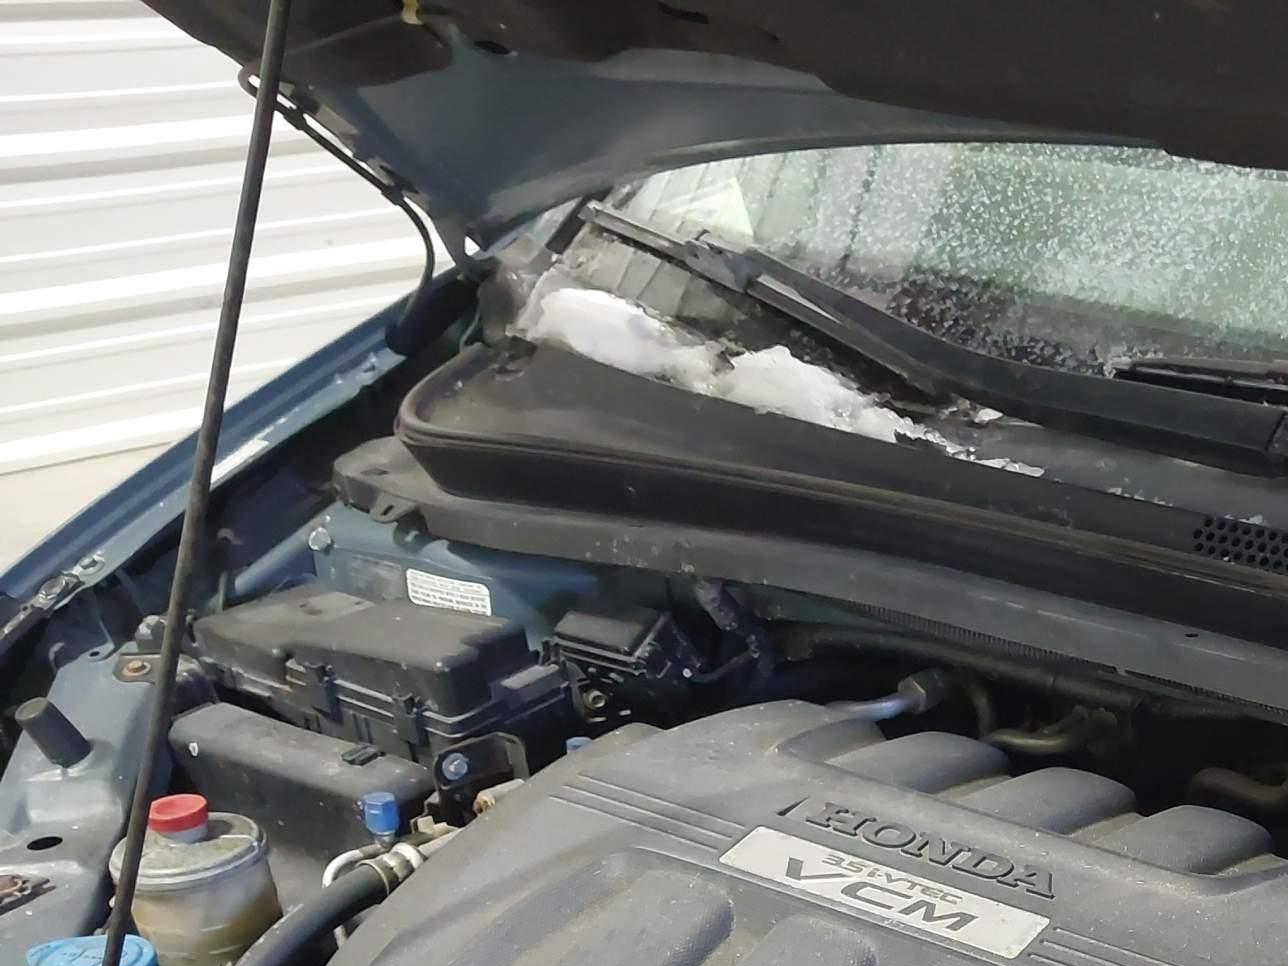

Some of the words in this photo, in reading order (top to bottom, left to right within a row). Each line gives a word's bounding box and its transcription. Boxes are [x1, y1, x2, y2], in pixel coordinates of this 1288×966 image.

[806, 802, 1056, 899] HONDA
[867, 867, 963, 905] i-VTEC
[786, 856, 978, 932] VCM
